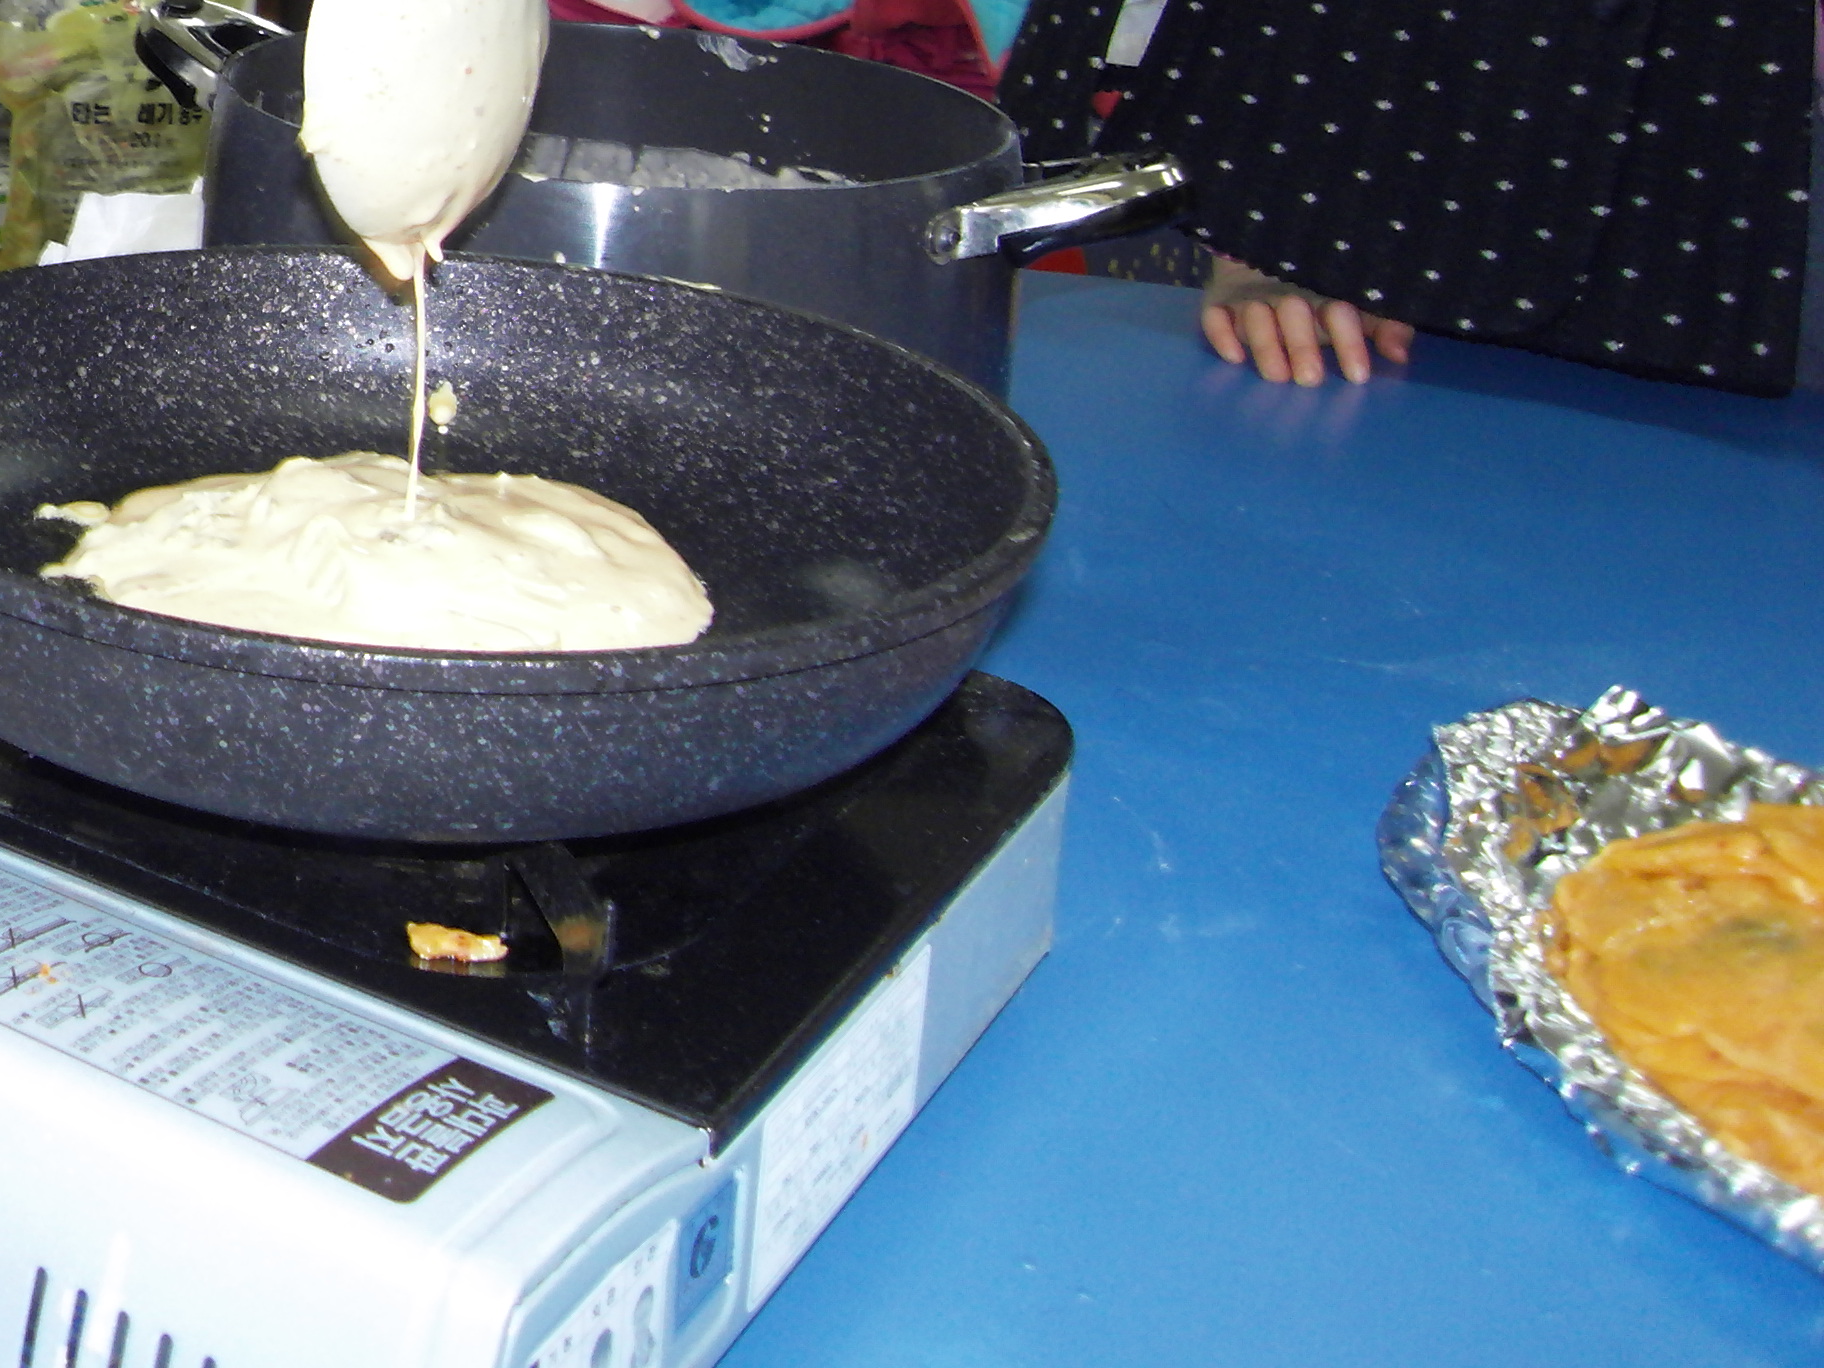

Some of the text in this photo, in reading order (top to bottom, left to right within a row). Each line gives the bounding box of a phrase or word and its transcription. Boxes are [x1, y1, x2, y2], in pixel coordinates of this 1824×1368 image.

[72, 101, 110, 125] 타는
[350, 1076, 476, 1158] 사용금지
[394, 1091, 521, 1175] 과대불판
